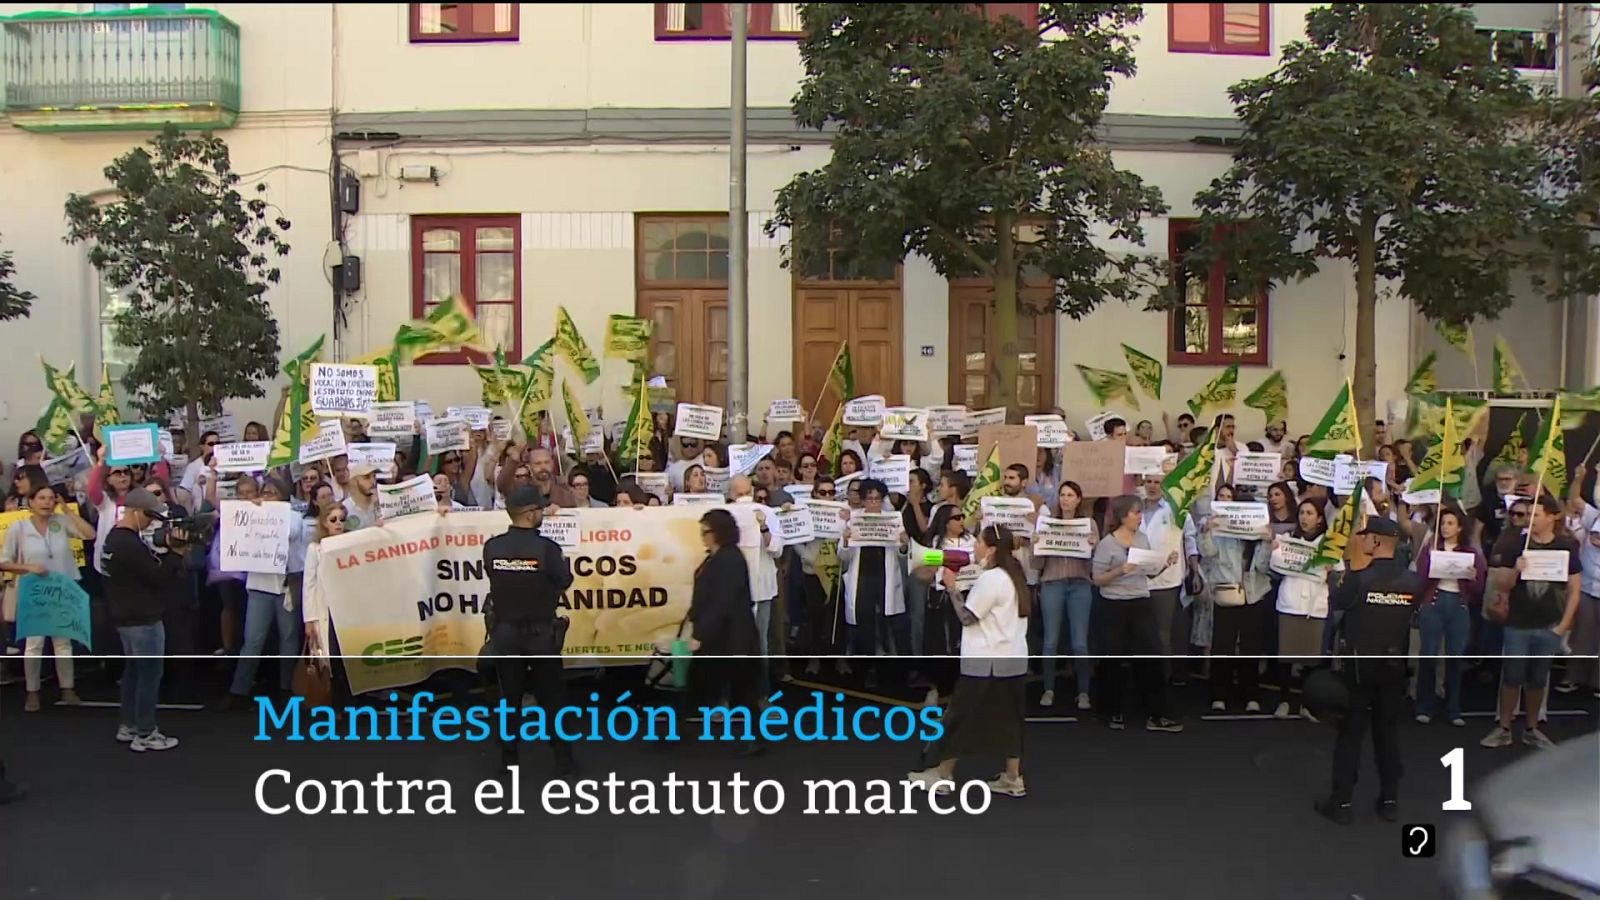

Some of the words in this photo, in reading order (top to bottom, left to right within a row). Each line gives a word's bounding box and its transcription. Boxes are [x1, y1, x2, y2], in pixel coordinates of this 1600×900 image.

[318, 366, 333, 378] NO
[336, 554, 360, 569] LA
[364, 537, 440, 563] SANIDAD
[437, 559, 483, 581] SIN
[417, 592, 453, 621] NO
[555, 587, 668, 610] ANIDAD
